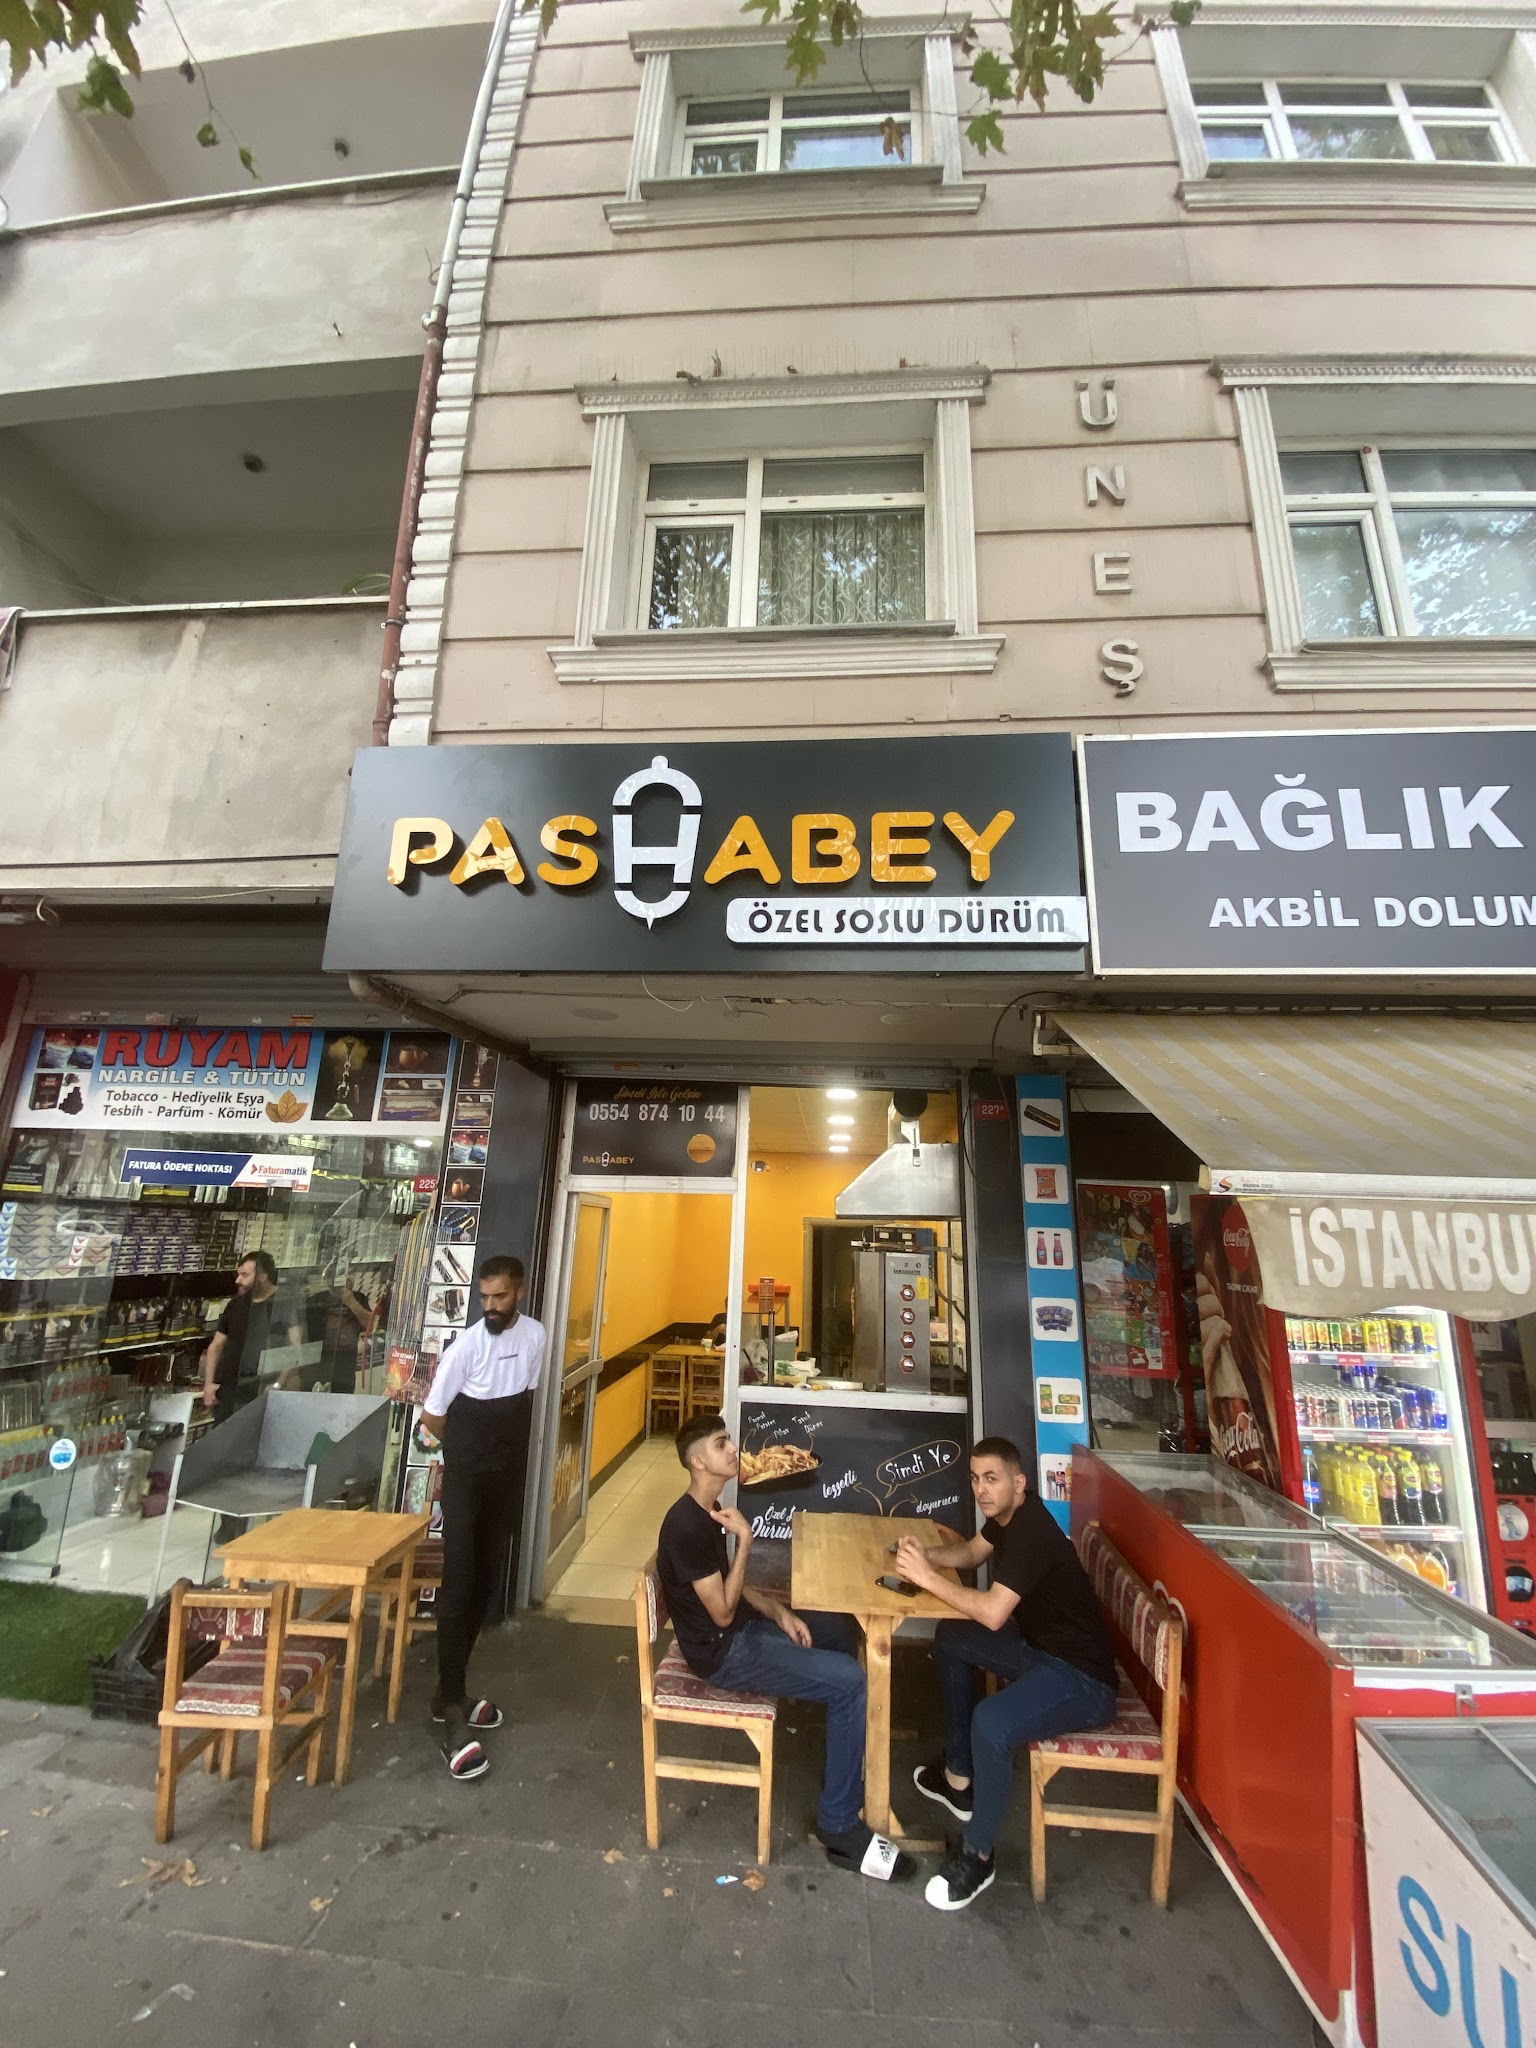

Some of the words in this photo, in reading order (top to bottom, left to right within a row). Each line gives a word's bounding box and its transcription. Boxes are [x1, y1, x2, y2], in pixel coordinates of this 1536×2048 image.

[1115, 773, 1525, 853] BAĞLIK
[386, 755, 1016, 931] PASHABEY
[748, 901, 823, 933] ÖZEL
[834, 908, 924, 933] SOSLU
[1208, 889, 1360, 928] AKBİL
[98, 1068, 194, 1084] NARGİLE
[229, 1069, 306, 1087] TÜTÜN
[106, 1090, 159, 1102] Tobacco
[172, 1092, 232, 1105] Hediyelik
[236, 1093, 265, 1106] Eşya
[103, 1105, 144, 1117] Tesbih
[157, 1106, 204, 1119] Parfüm
[217, 1107, 263, 1119] Kömür
[589, 1103, 630, 1121] 0554
[638, 1104, 669, 1122] 874
[679, 1104, 696, 1122] 10
[704, 1105, 726, 1123] 44
[128, 1161, 161, 1171] FATURA
[163, 1160, 194, 1172] ÖDEME
[195, 1164, 233, 1175] NOKTASI
[258, 1165, 308, 1177] Faturamatik
[1288, 1207, 1536, 1295] İSTANBU
[928, 1445, 951, 1469] Ye
